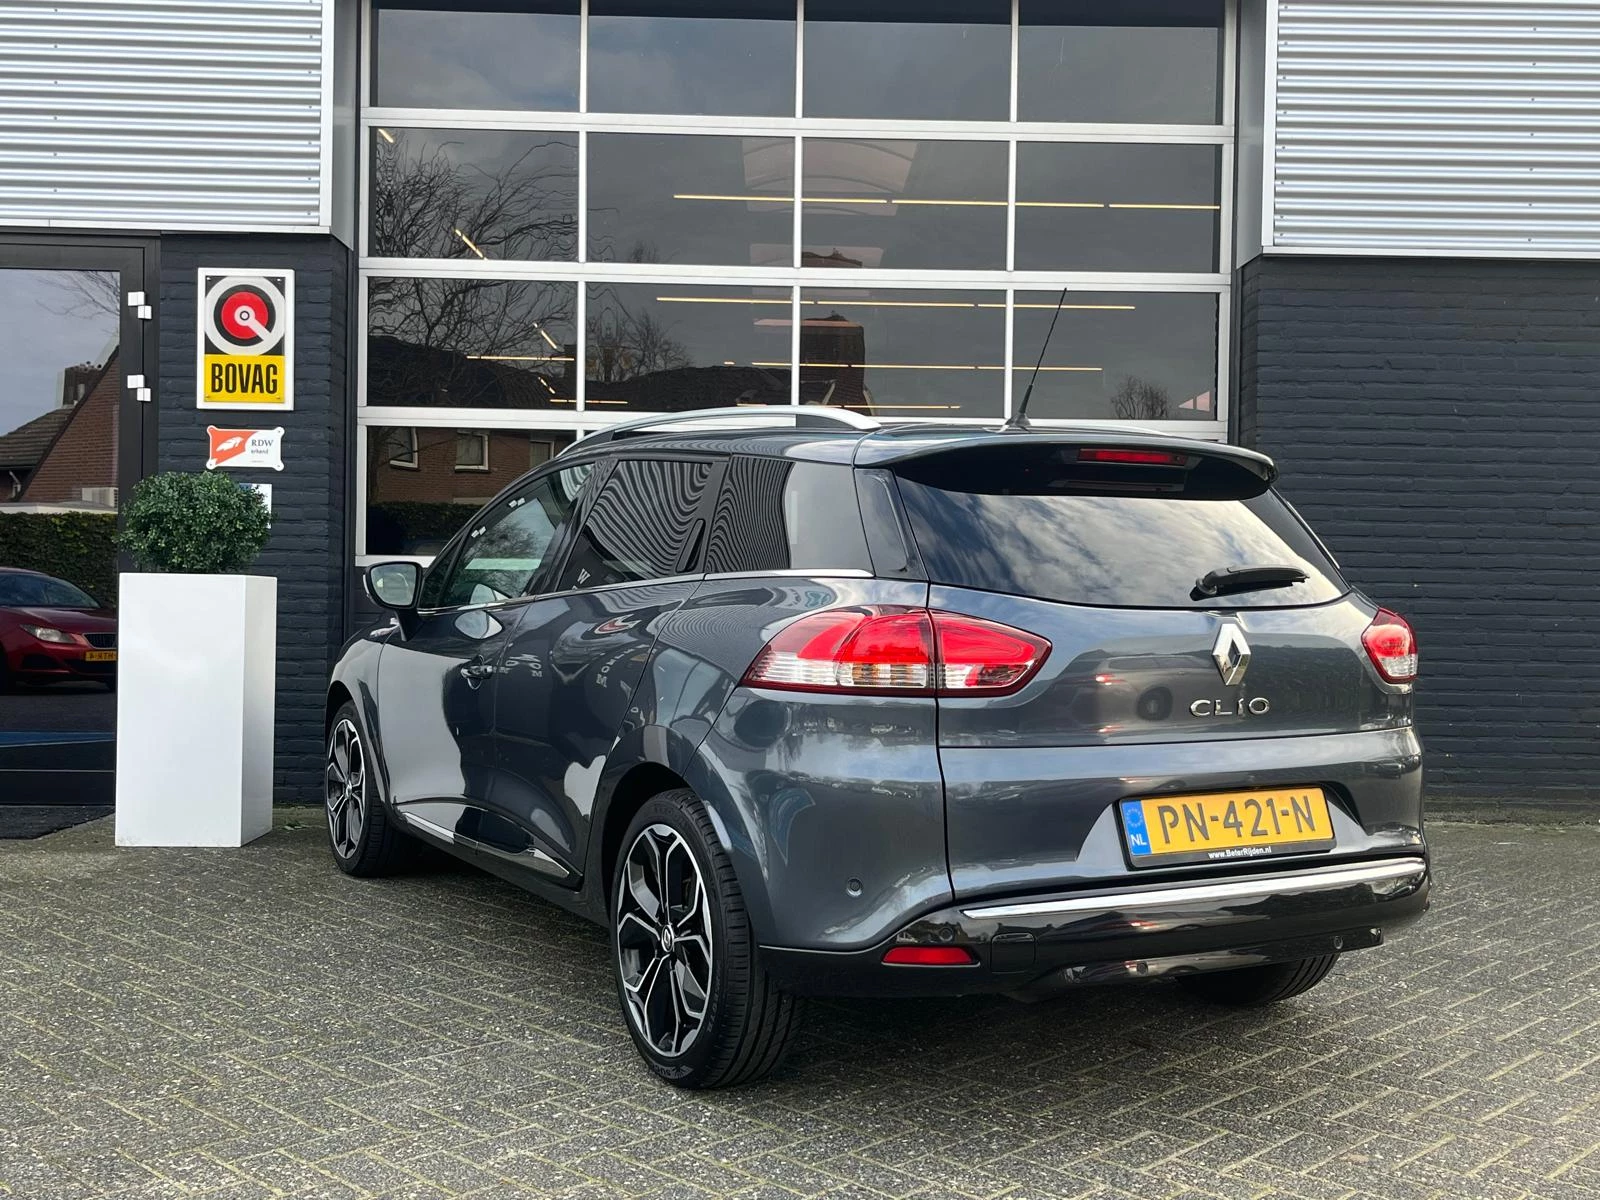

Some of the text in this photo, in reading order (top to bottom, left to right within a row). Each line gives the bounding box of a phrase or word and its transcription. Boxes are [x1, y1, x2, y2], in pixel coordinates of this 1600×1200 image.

[211, 363, 278, 394] BOVAG
[251, 439, 274, 447] RDW
[1190, 697, 1270, 716] CLIO
[1158, 795, 1316, 844] PN-421-N
[1131, 834, 1147, 846] NL
[1208, 846, 1271, 858] www.BeterRijden.nl
